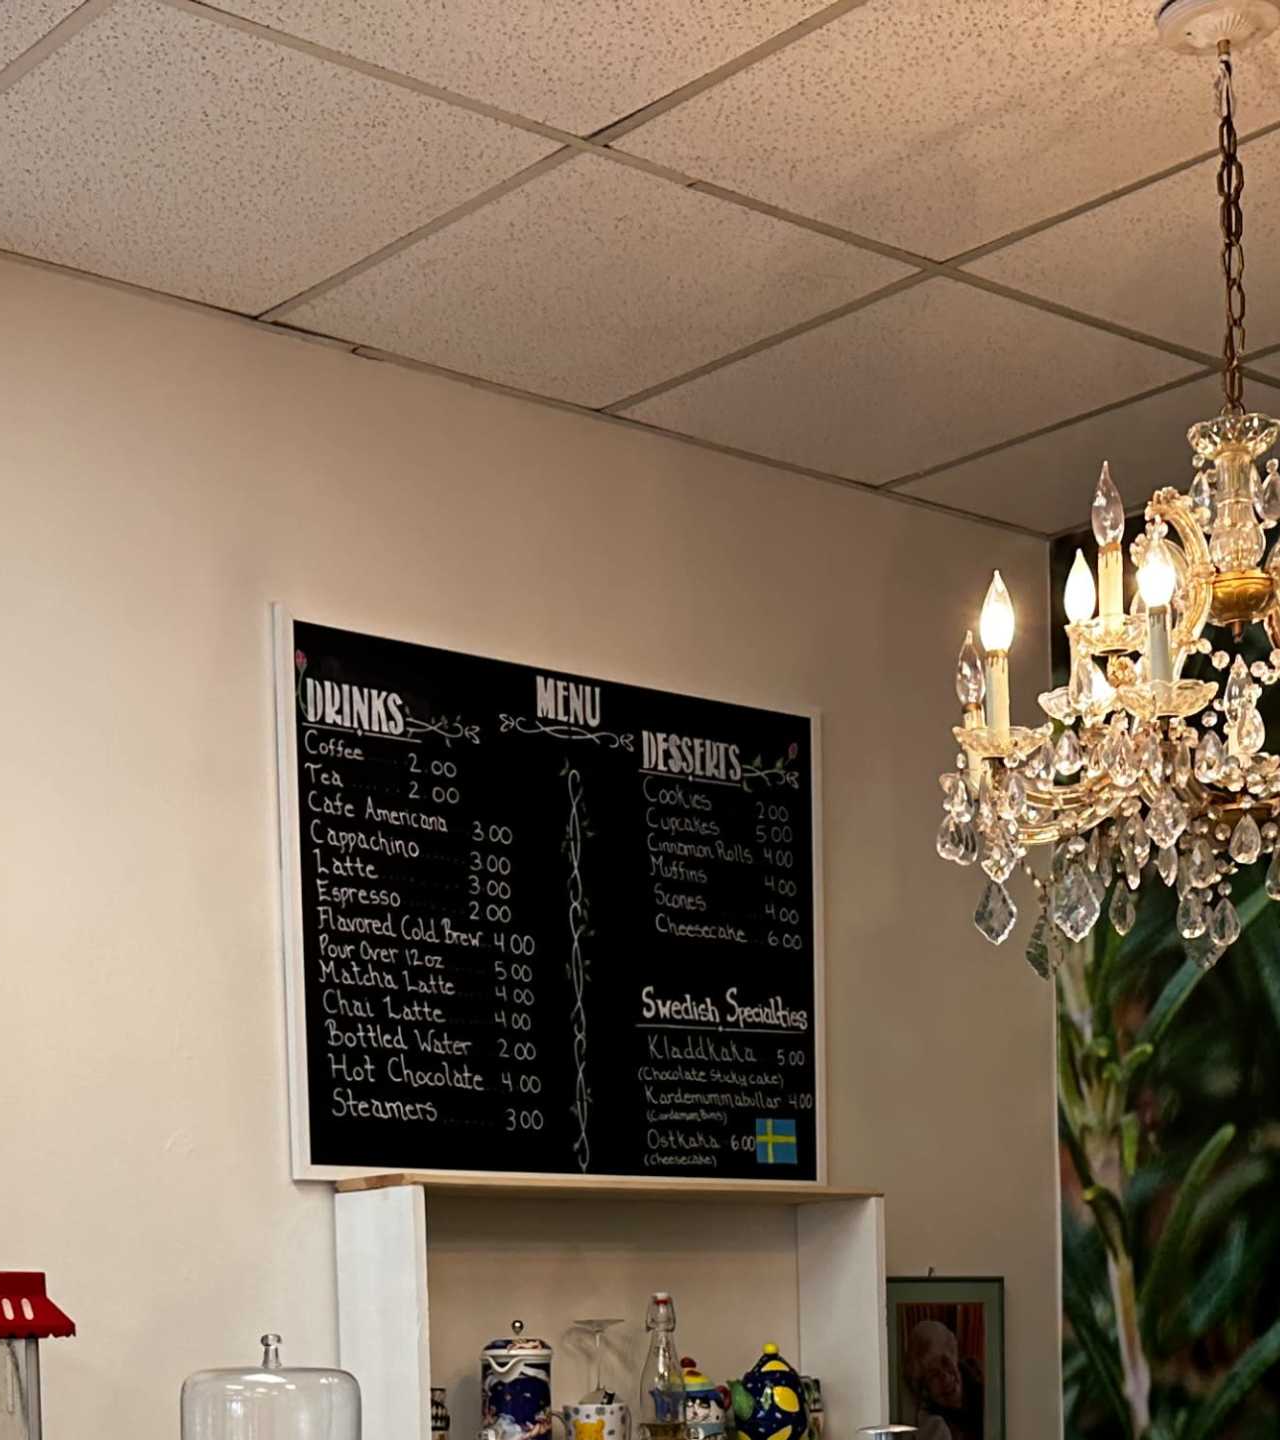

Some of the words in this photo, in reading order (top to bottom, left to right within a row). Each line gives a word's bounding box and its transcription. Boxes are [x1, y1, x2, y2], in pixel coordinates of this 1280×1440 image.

[306, 678, 404, 735] DRINKS
[536, 675, 600, 728] MENU
[304, 729, 365, 760] Coffee
[641, 729, 742, 781] DESSERTS
[304, 762, 344, 788] Tea
[308, 790, 355, 818] Cafe
[643, 776, 713, 812] Cookies
[646, 806, 721, 836] Cupcakes
[310, 819, 420, 858] Cappachino
[647, 832, 715, 859] Cinnamon
[715, 840, 754, 865] Rolls
[313, 848, 379, 879] Latte
[650, 854, 708, 884] Muffins
[316, 878, 401, 908] Espresso
[654, 882, 708, 912] Scones
[317, 906, 397, 937] Flavored
[400, 914, 441, 943] Cold
[441, 917, 484, 947] Brew
[655, 913, 748, 944] Cheesecake
[319, 934, 356, 959] Pour
[360, 940, 400, 964] Over
[318, 959, 399, 990] Matcha
[402, 970, 456, 996] Latte
[322, 988, 375, 1018] Chai
[383, 995, 447, 1023] Latte
[641, 985, 720, 1023] Swedish
[726, 987, 808, 1030] Specialties
[325, 1018, 408, 1050] Bottled
[414, 1028, 472, 1055] Water
[647, 1032, 758, 1063] Kladdkaka
[328, 1053, 376, 1083] Hot
[387, 1053, 486, 1091] Chocolate
[331, 1088, 438, 1122] Steamers
[647, 1128, 720, 1150] Ostkaka
